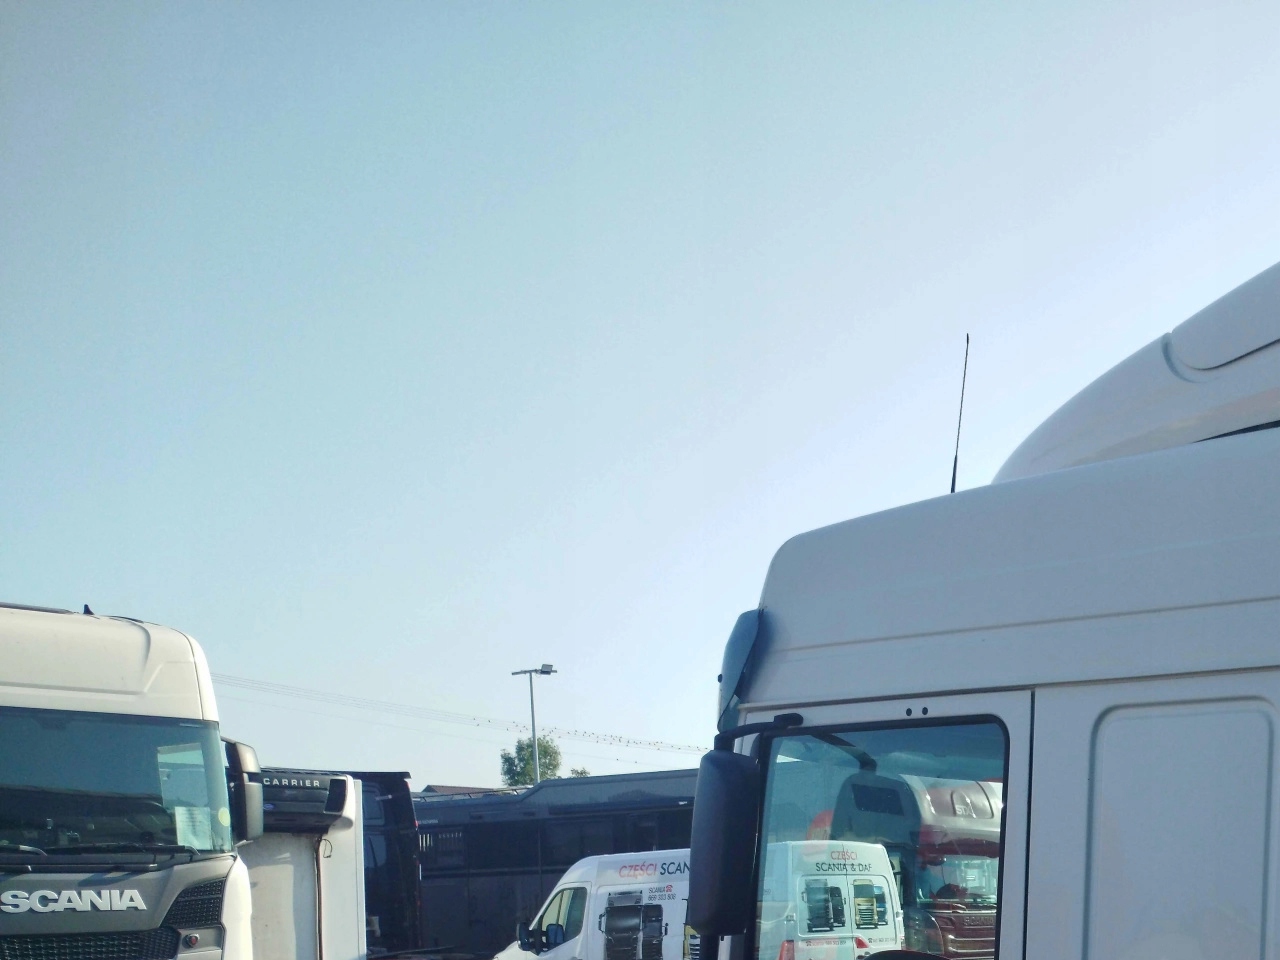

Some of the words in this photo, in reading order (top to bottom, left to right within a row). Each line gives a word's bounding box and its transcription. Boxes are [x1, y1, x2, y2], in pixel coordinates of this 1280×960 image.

[263, 778, 320, 787] CARRIER
[815, 862, 847, 872] SCANIA
[0, 889, 147, 913] SCANIA
